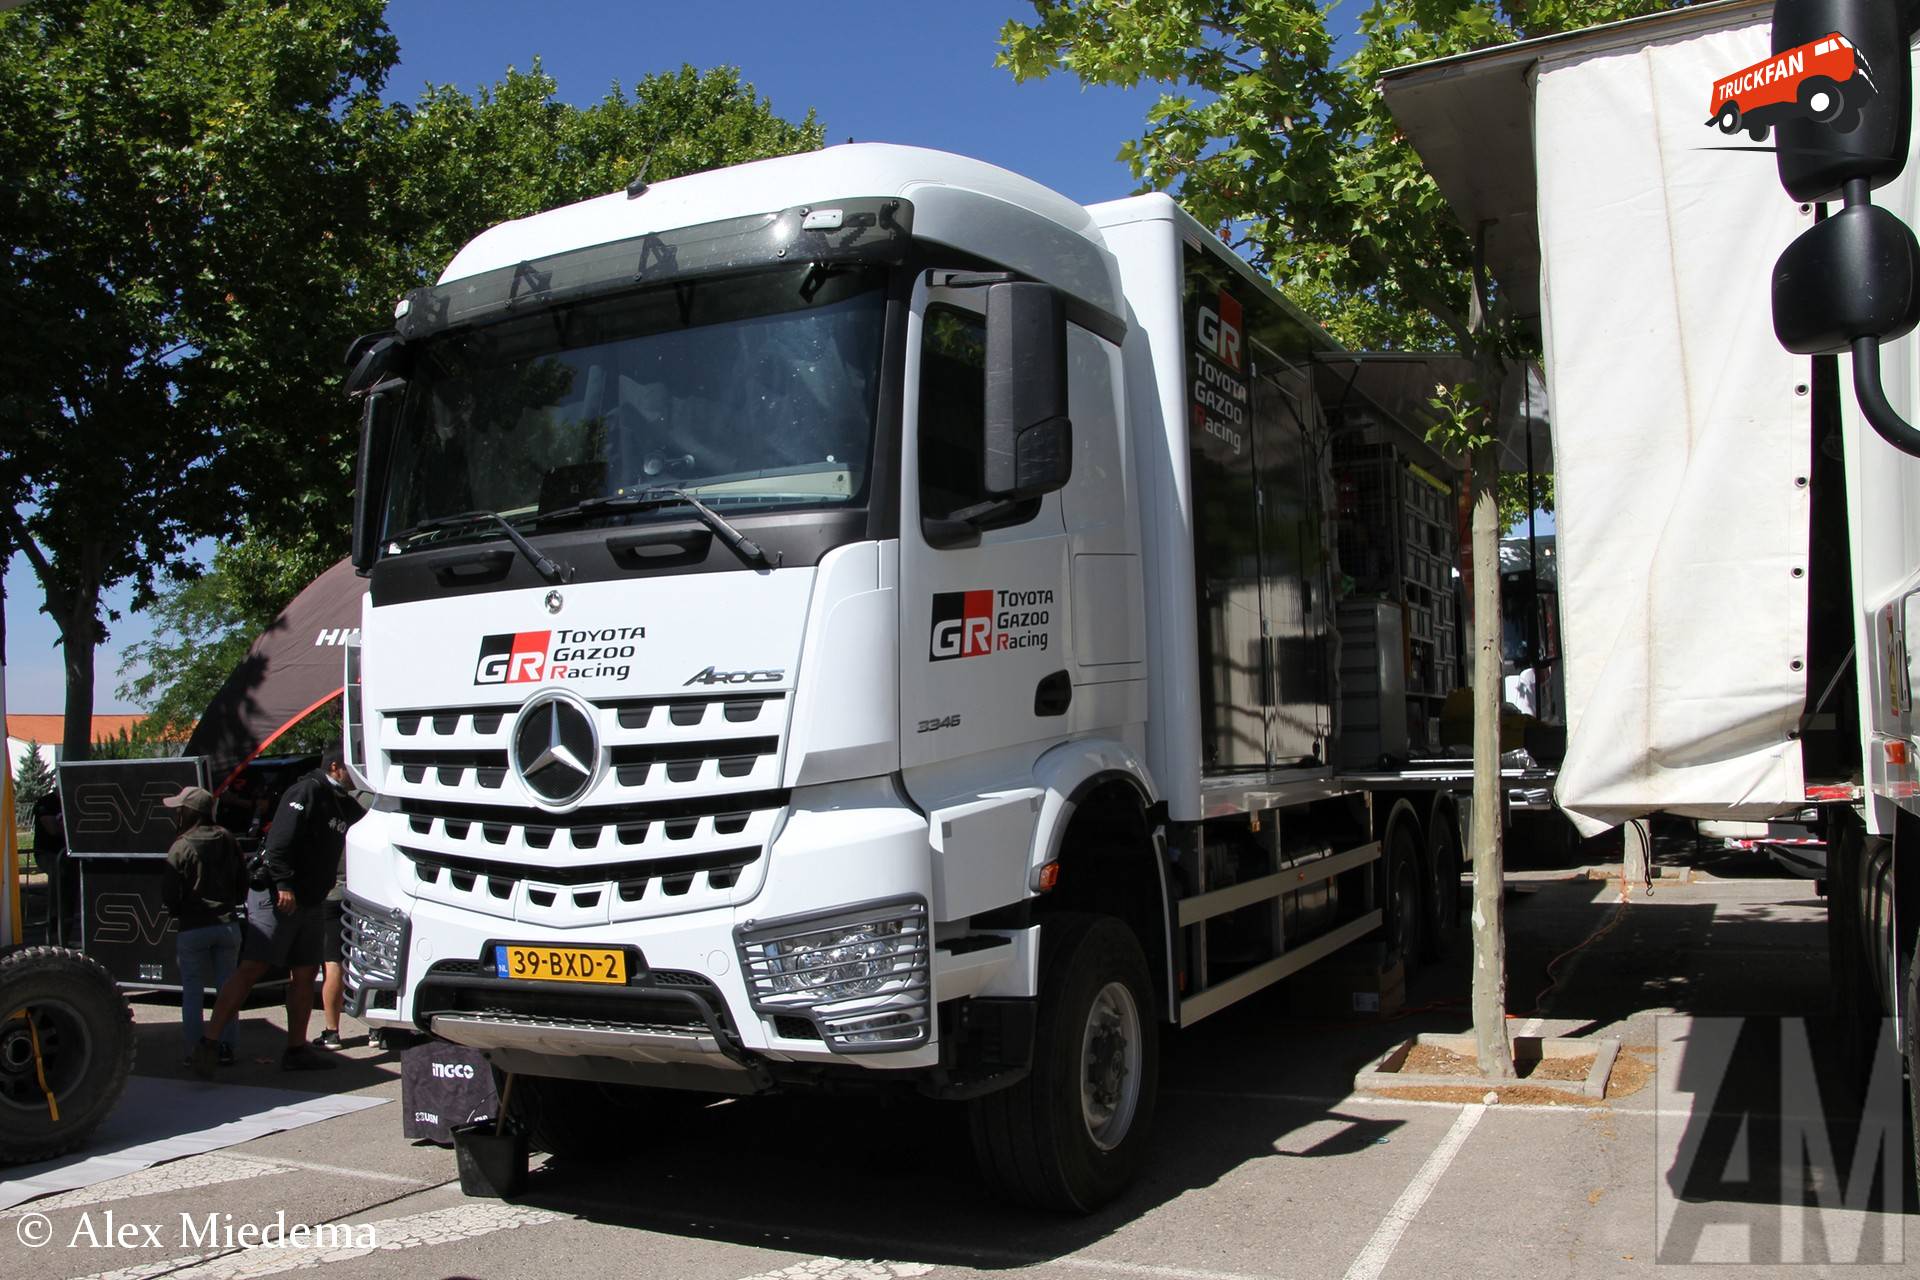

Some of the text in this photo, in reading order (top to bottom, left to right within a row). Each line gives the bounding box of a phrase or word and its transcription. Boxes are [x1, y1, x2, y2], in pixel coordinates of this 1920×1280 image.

[1198, 306, 1241, 369] GR
[1195, 352, 1247, 403] TOYOTA
[1195, 379, 1242, 424] GAZOO
[1194, 401, 1241, 455] Racing
[997, 590, 1053, 607] TOYOTA
[997, 611, 1049, 629] GAZOO
[558, 627, 646, 644] TOYOTA
[932, 616, 992, 657] GR
[997, 630, 1048, 651] Racing
[477, 651, 545, 683] GR
[553, 646, 635, 662] GAZOO
[550, 663, 630, 681] Racing
[94, 893, 179, 946] SV
[498, 950, 618, 979] NL 39-BXD-2
